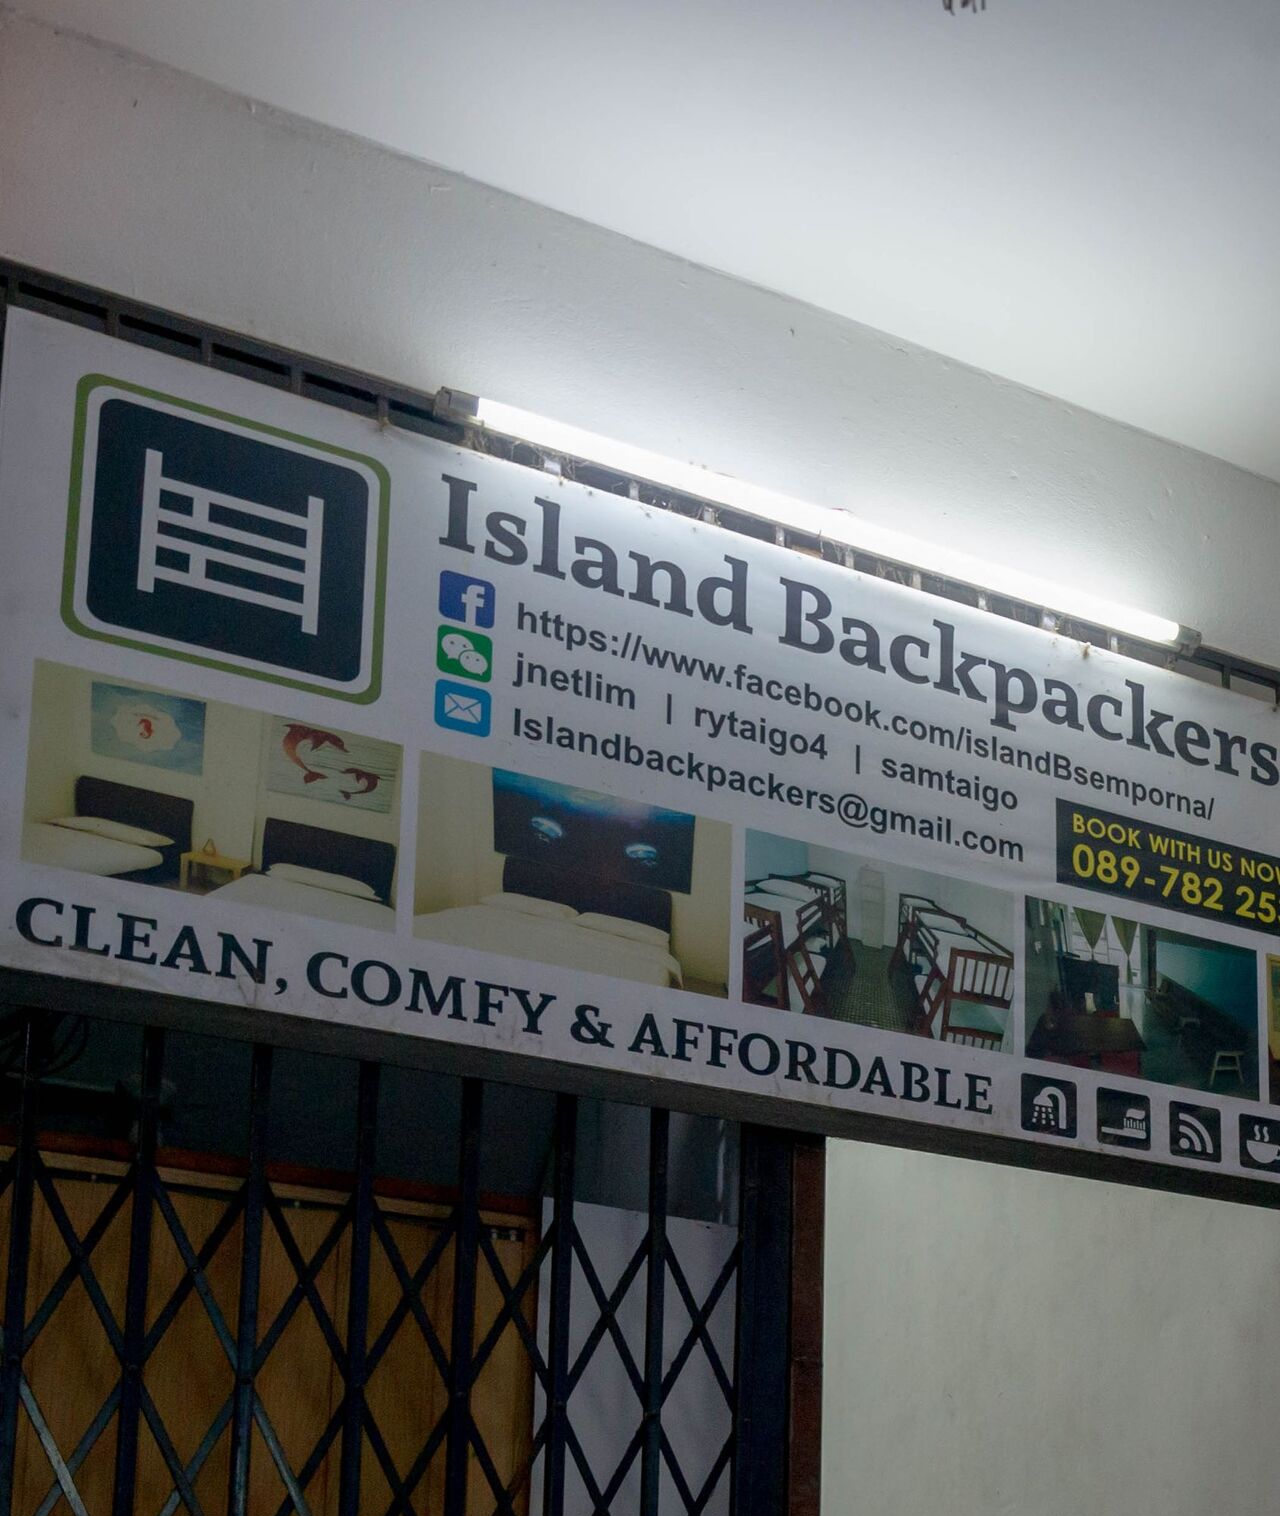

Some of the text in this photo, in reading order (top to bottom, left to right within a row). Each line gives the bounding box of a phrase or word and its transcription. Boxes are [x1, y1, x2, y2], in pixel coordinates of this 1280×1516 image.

[439, 474, 1280, 786] Island Backpackers
[517, 602, 1215, 820] https://www.facebook.com/islandBsemporna/
[512, 653, 636, 709] jnetlim
[695, 706, 828, 760] rytaigo4
[881, 757, 1018, 812] samtaigo
[1071, 843, 1225, 912] 089-782
[1072, 813, 1141, 848] BOOK
[1149, 833, 1201, 866] WITH
[1208, 848, 1233, 872] US
[15, 897, 994, 1115] CLEAN, COMFY & AFFORDABLE
